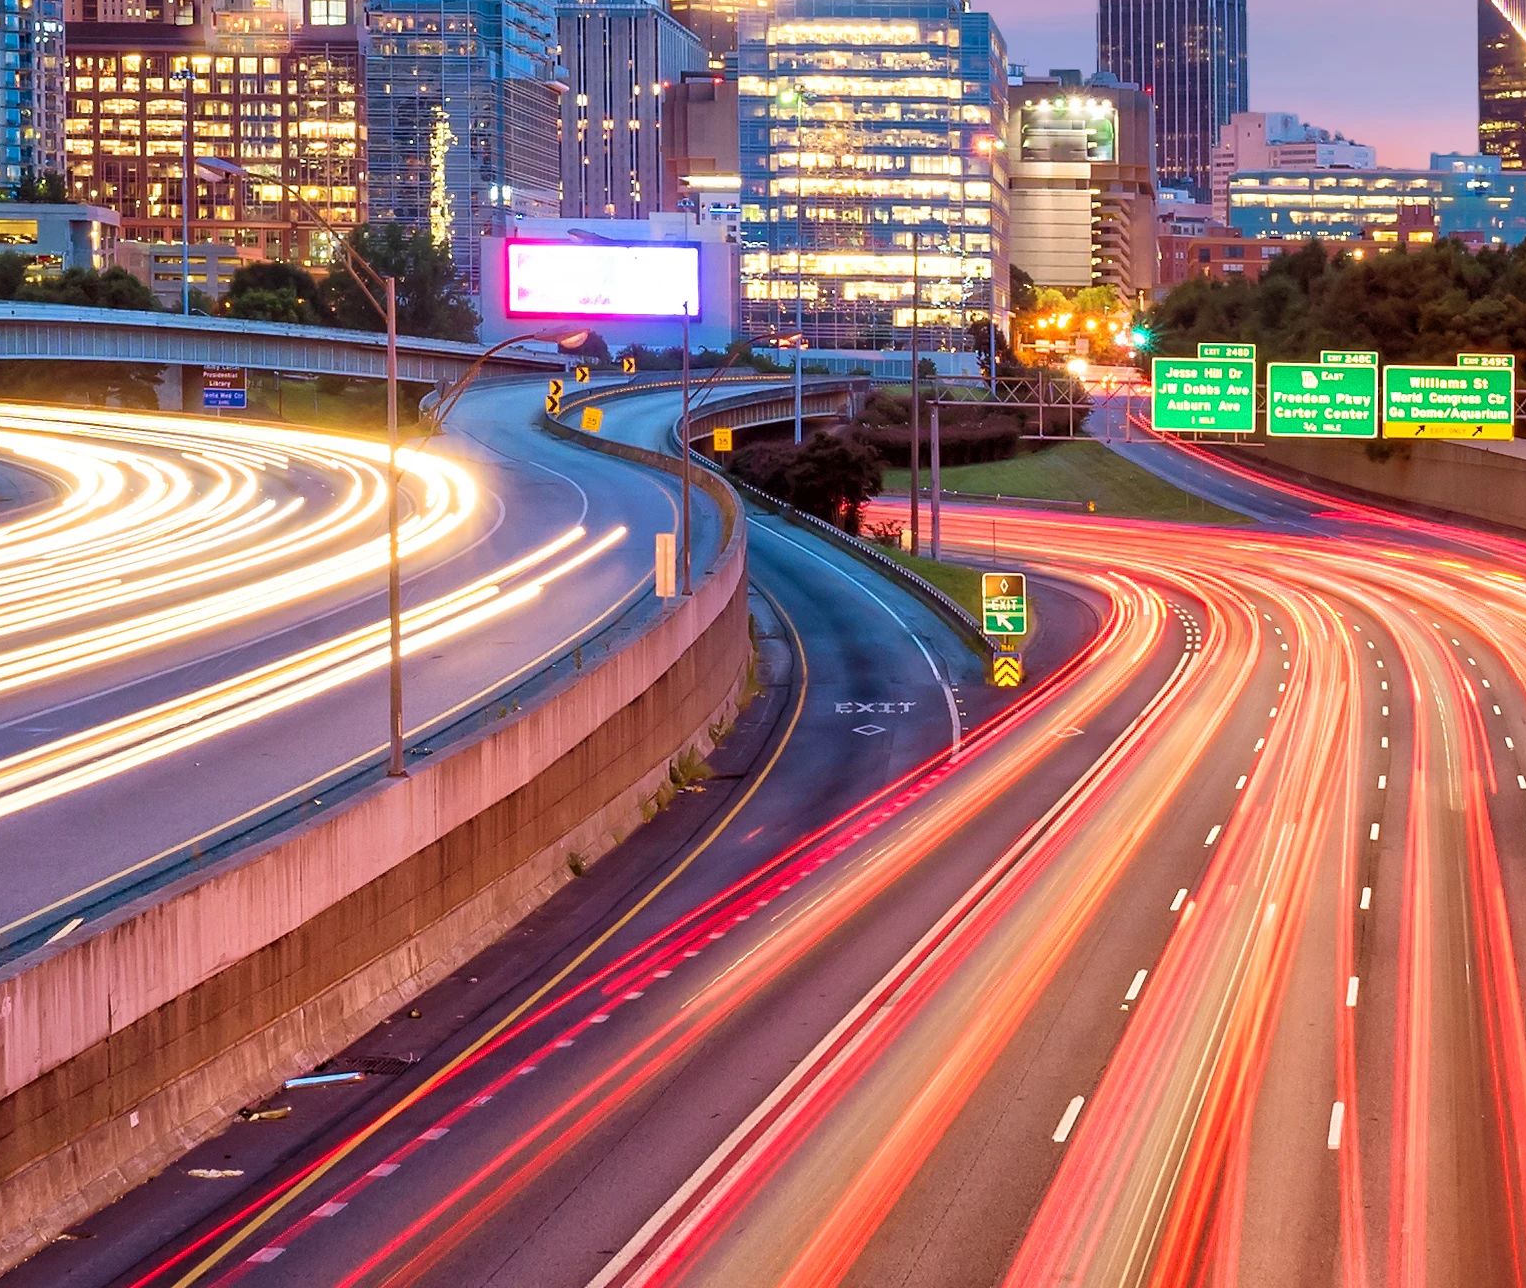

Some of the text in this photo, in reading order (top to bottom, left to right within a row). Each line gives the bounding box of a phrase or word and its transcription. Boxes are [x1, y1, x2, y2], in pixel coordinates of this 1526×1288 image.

[1165, 366, 1243, 380] Jesse Hill Dr
[1321, 371, 1345, 381] EAST
[209, 380, 231, 388] Library
[1158, 382, 1250, 396] JW Dobbs Ave
[1409, 376, 1489, 390] Williams St
[1166, 398, 1241, 412] Auburn Ave
[1273, 391, 1371, 408] Freedom Pkwy
[1390, 391, 1507, 408] World Congress Ctr
[1274, 405, 1370, 420] Carter Center
[1388, 405, 1509, 422] Ga Dome/Aquarium
[991, 599, 1018, 611] EXIT
[834, 701, 917, 714] EXIT
